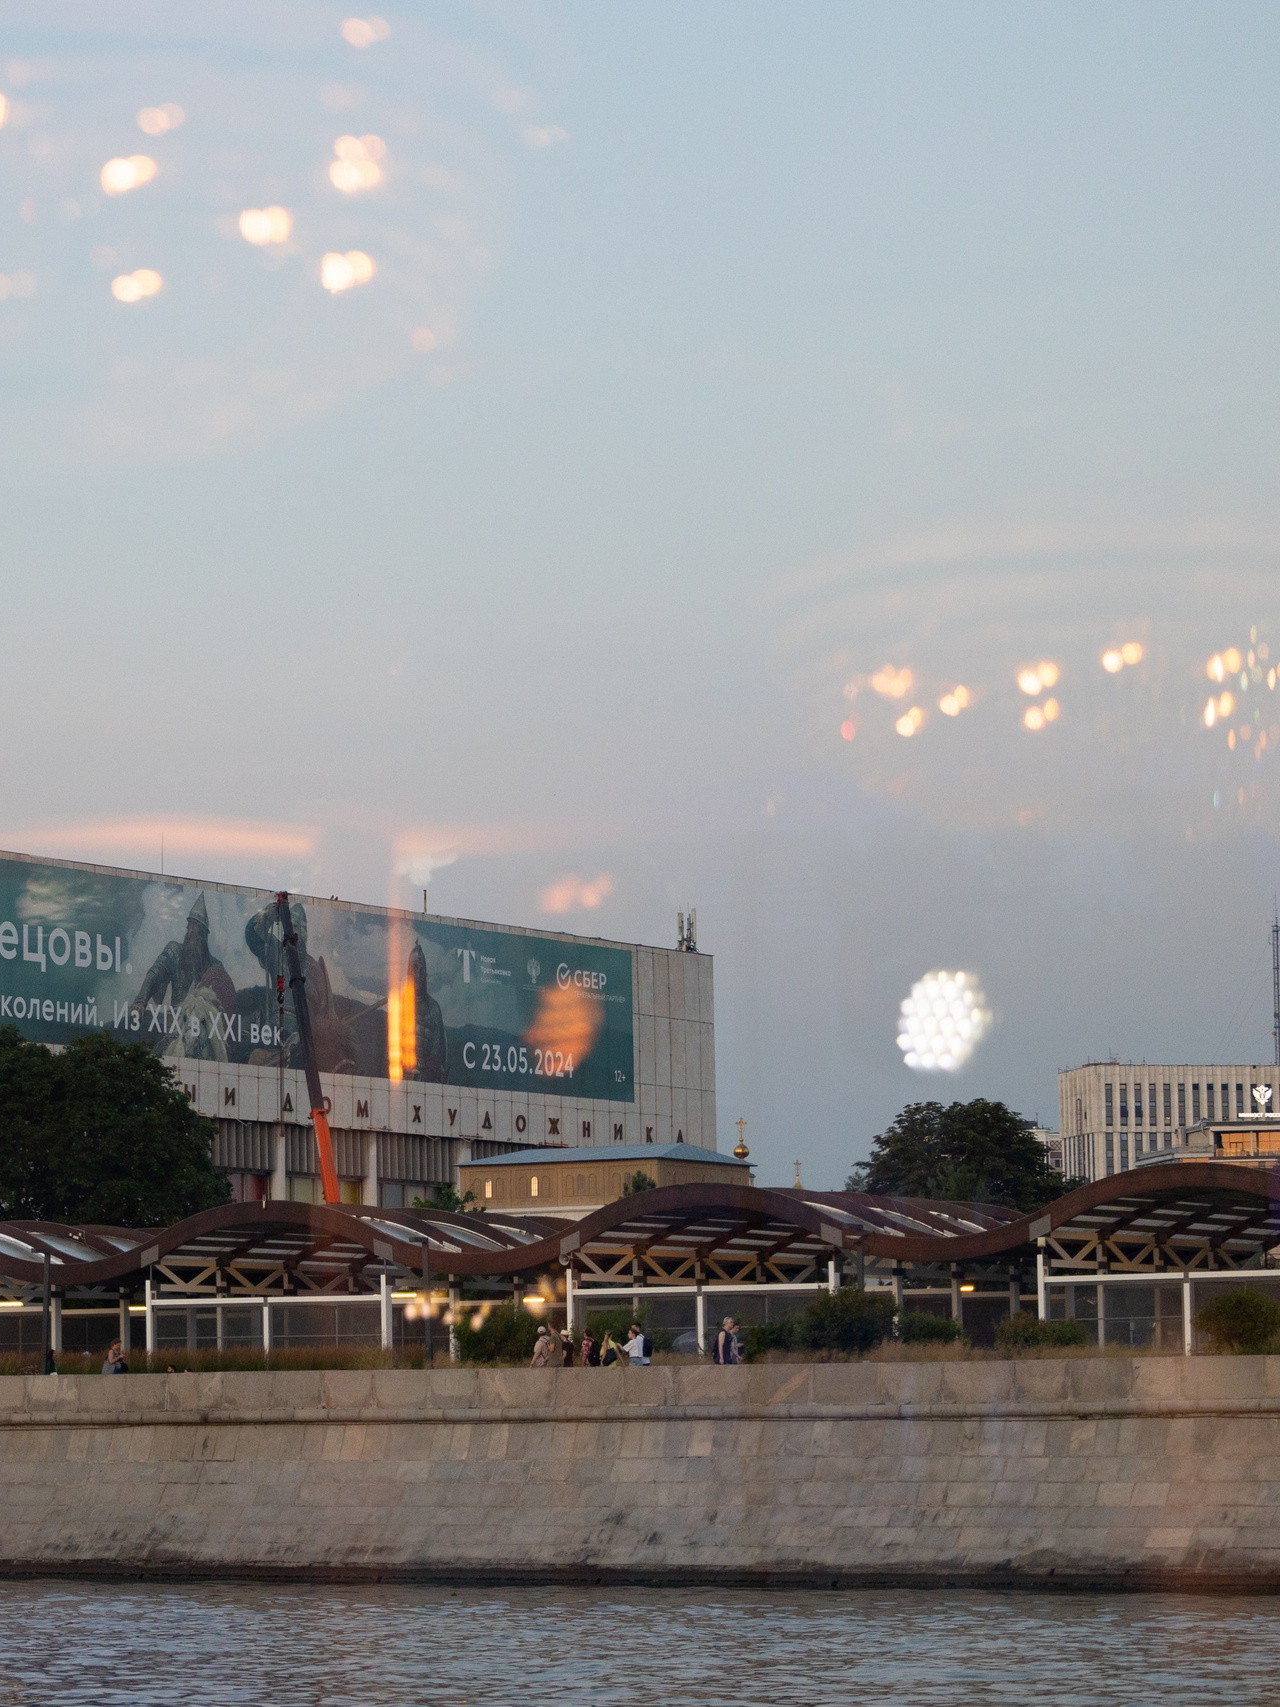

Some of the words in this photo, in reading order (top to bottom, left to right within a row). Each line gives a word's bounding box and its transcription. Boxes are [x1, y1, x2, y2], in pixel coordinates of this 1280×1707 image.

[573, 969, 607, 990] СБЕР
[113, 999, 141, 1032] Из
[147, 1003, 183, 1036] XIX
[190, 1016, 201, 1038] в
[207, 1011, 243, 1043] XXI
[462, 1041, 476, 1069] С
[481, 1043, 575, 1079] 23.05.2024
[613, 1069, 627, 1083] 12+
[411, 1104, 685, 1144] ХУДОЖНИКА
